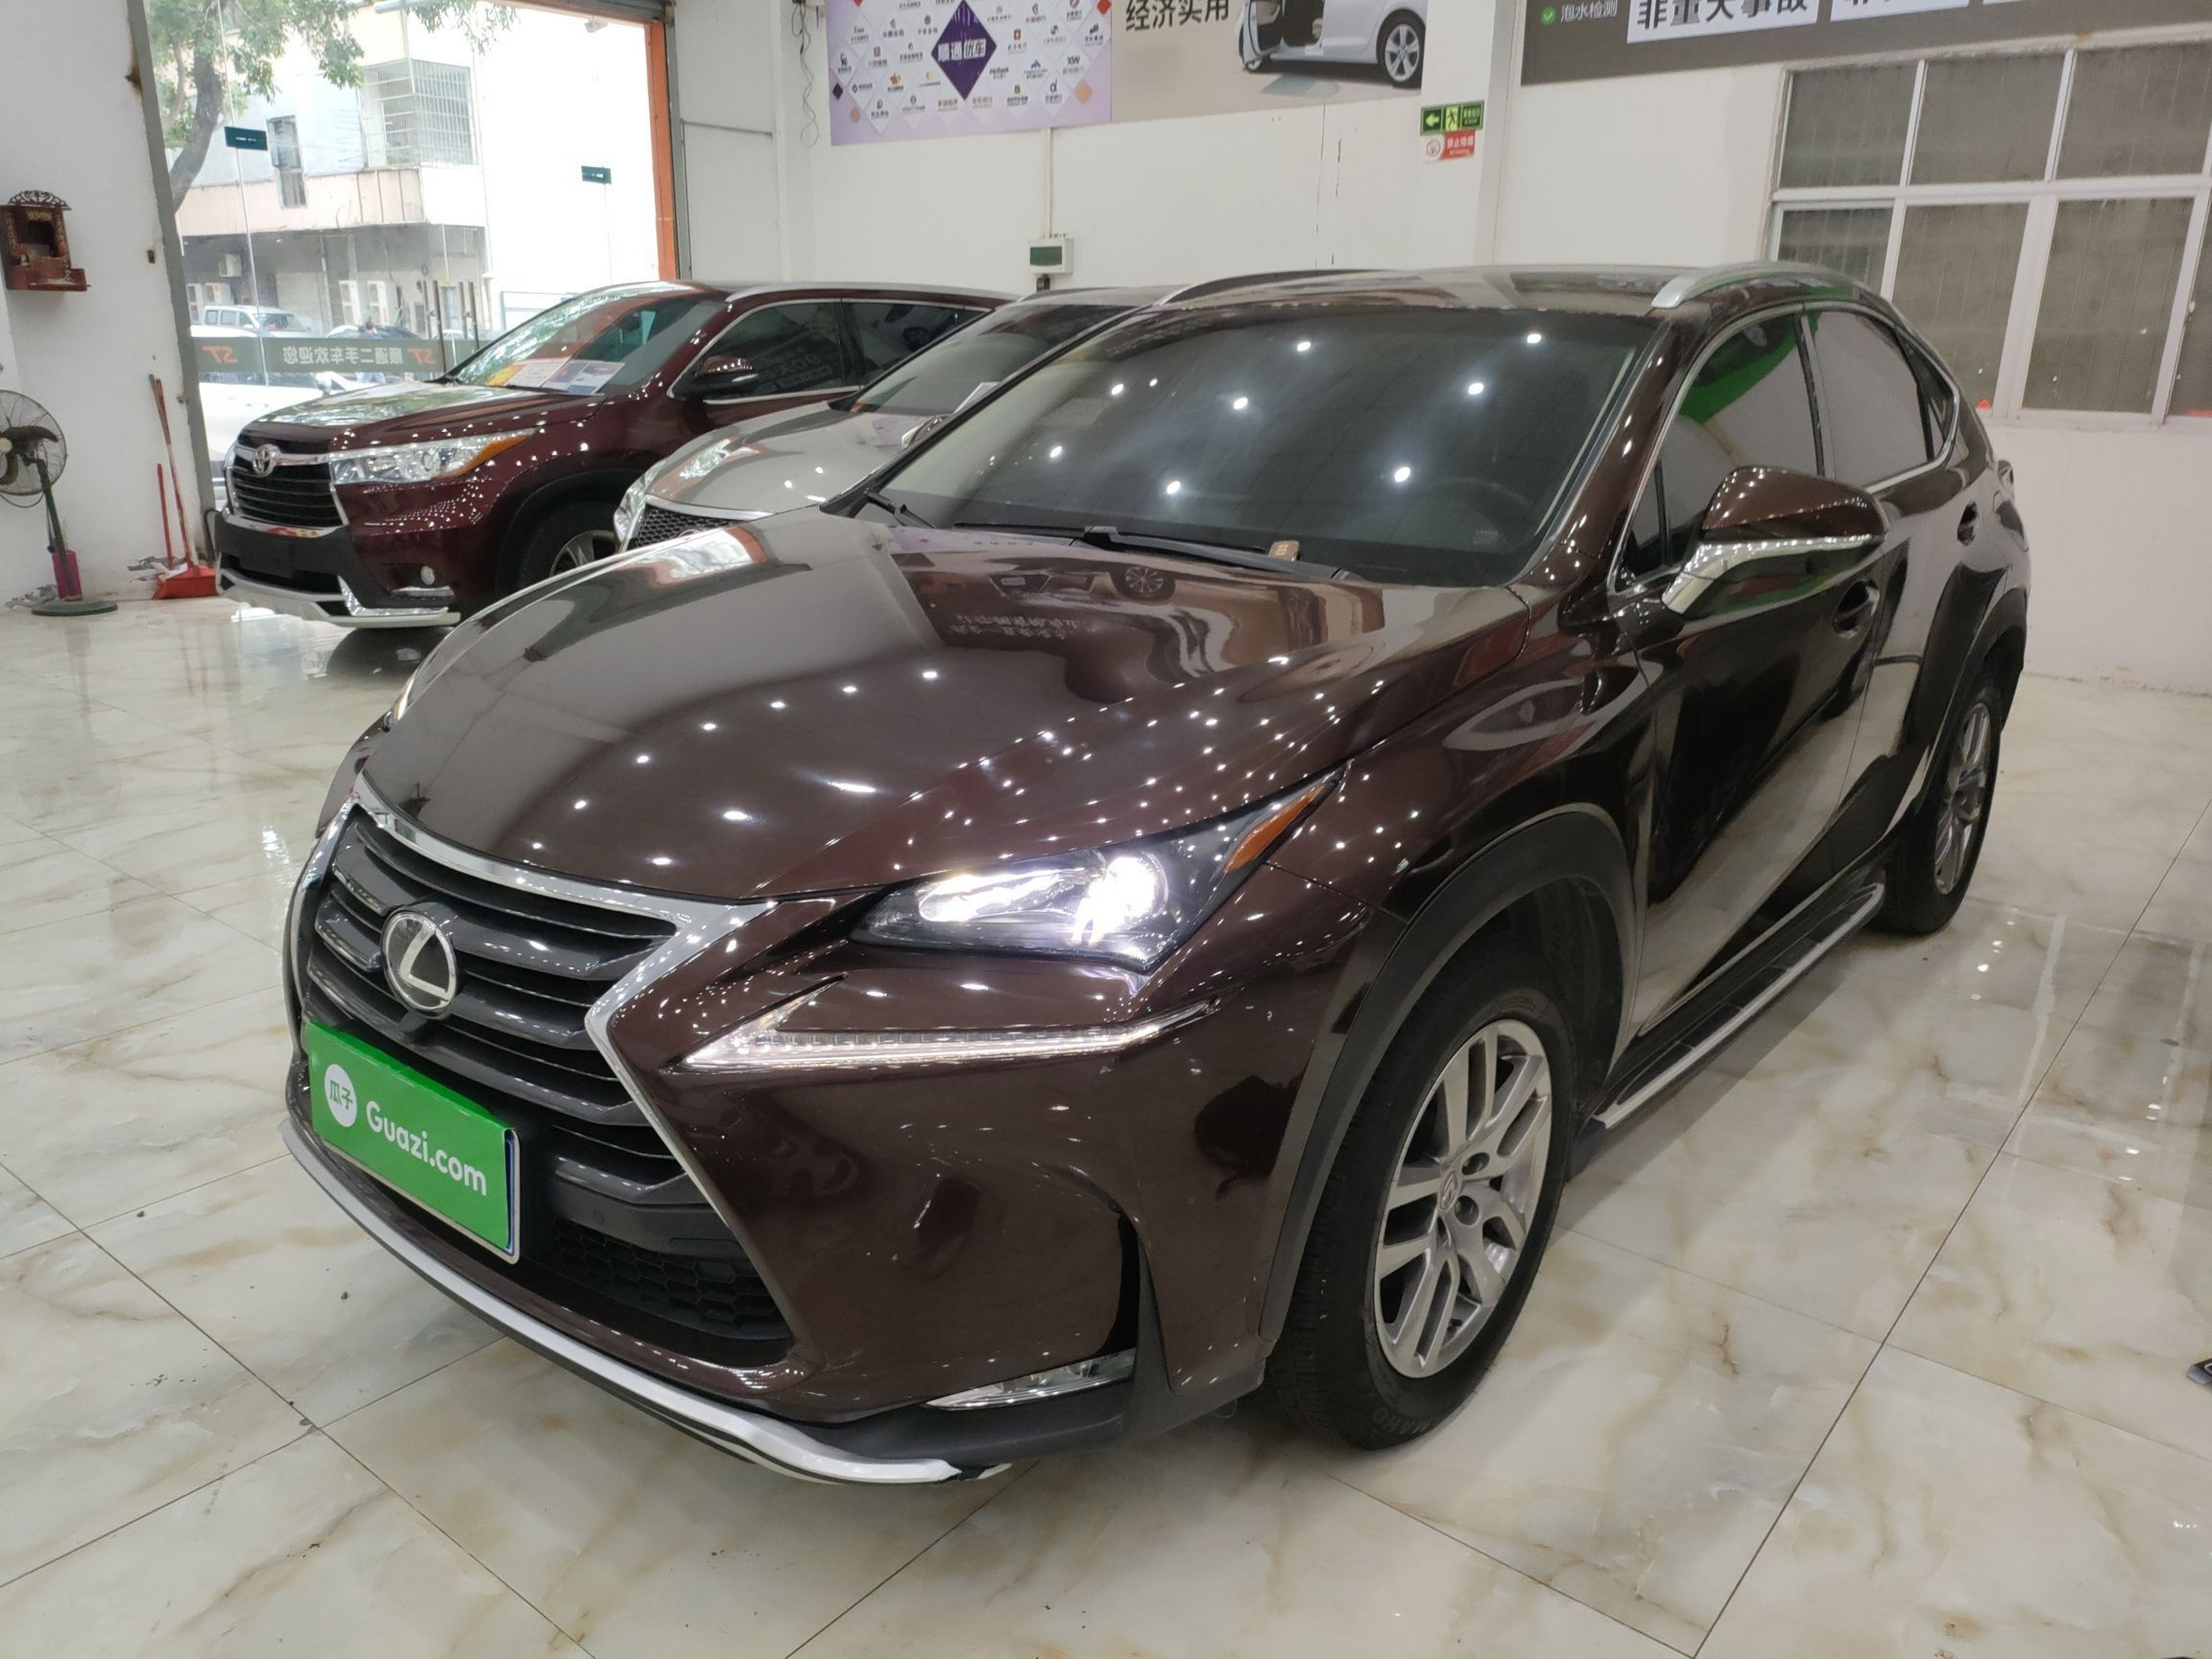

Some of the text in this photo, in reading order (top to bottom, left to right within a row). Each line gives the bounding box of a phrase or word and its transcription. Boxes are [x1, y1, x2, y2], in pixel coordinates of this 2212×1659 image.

[1126, 0, 1229, 31] 经济实用
[329, 1079, 353, 1110] 瓜子
[366, 1100, 487, 1196] Guazi.com
